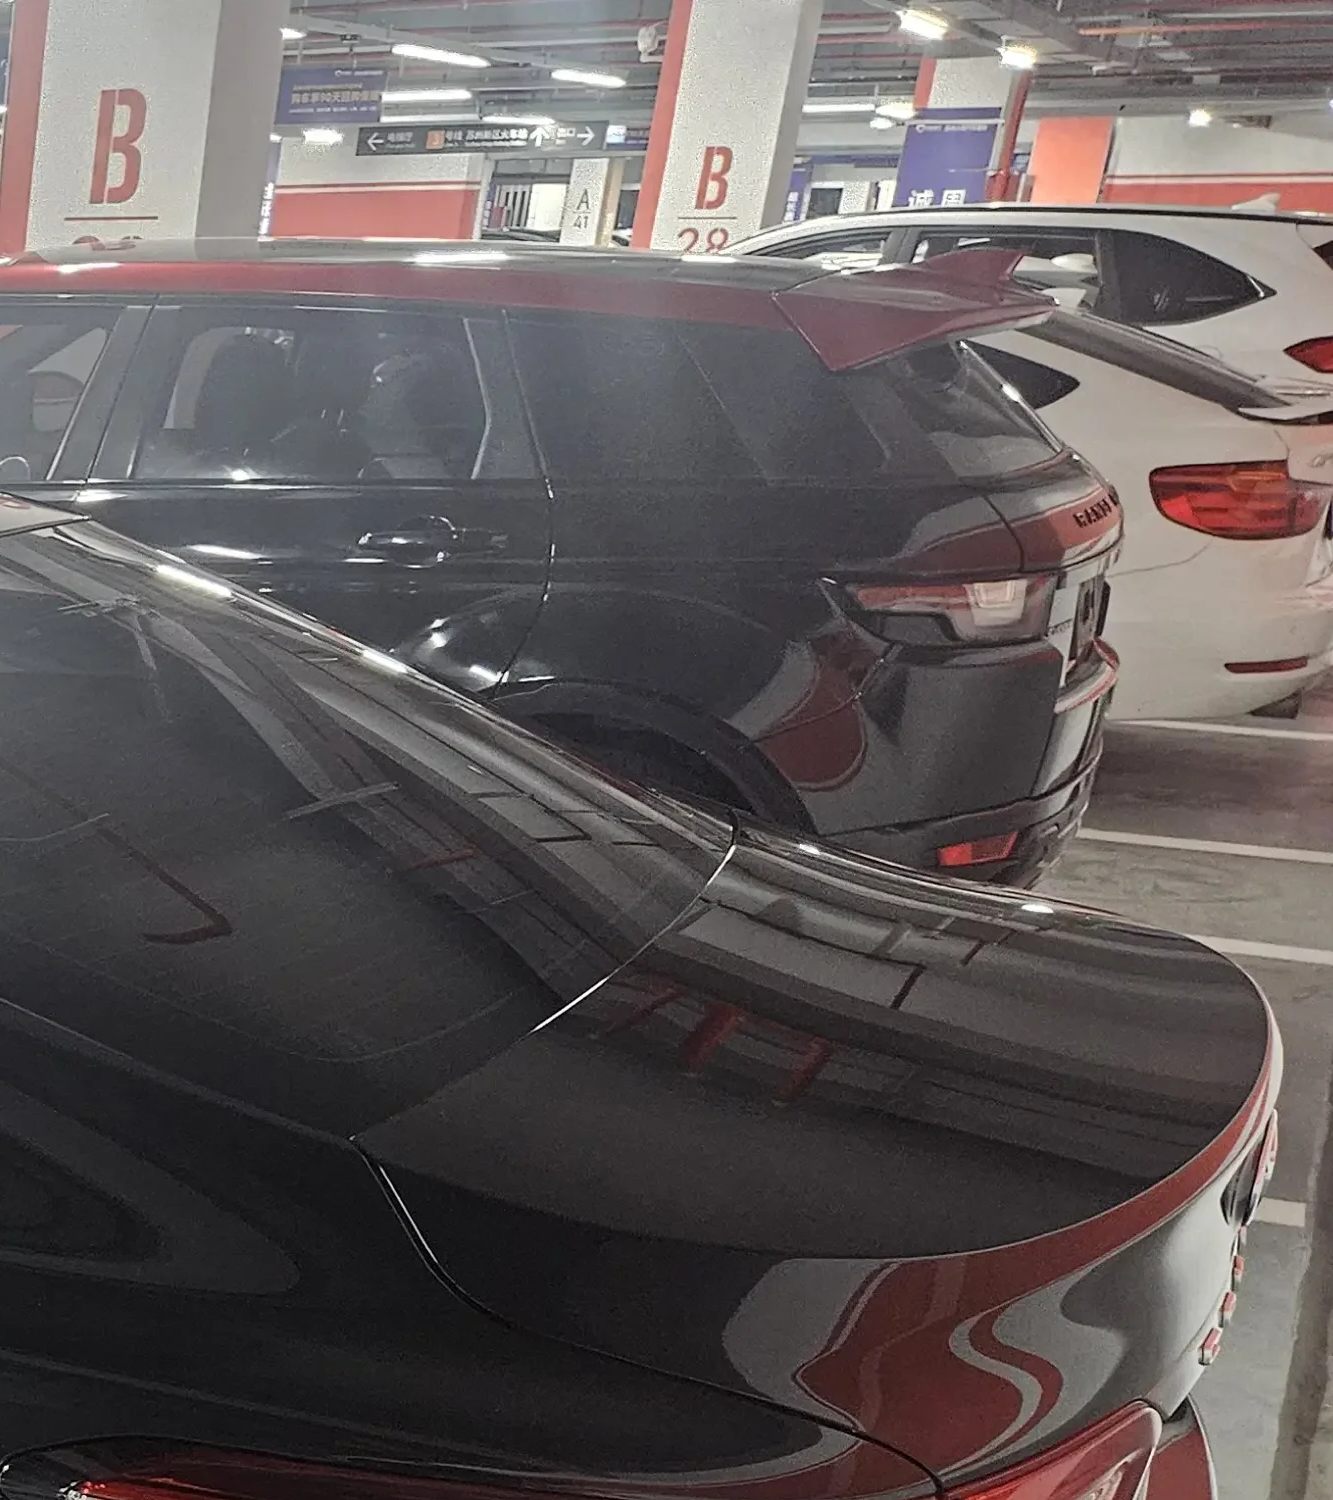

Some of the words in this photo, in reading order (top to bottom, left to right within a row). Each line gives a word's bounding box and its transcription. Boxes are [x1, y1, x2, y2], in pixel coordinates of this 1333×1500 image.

[89, 88, 147, 205] B
[695, 146, 734, 210] B
[577, 189, 590, 210] A
